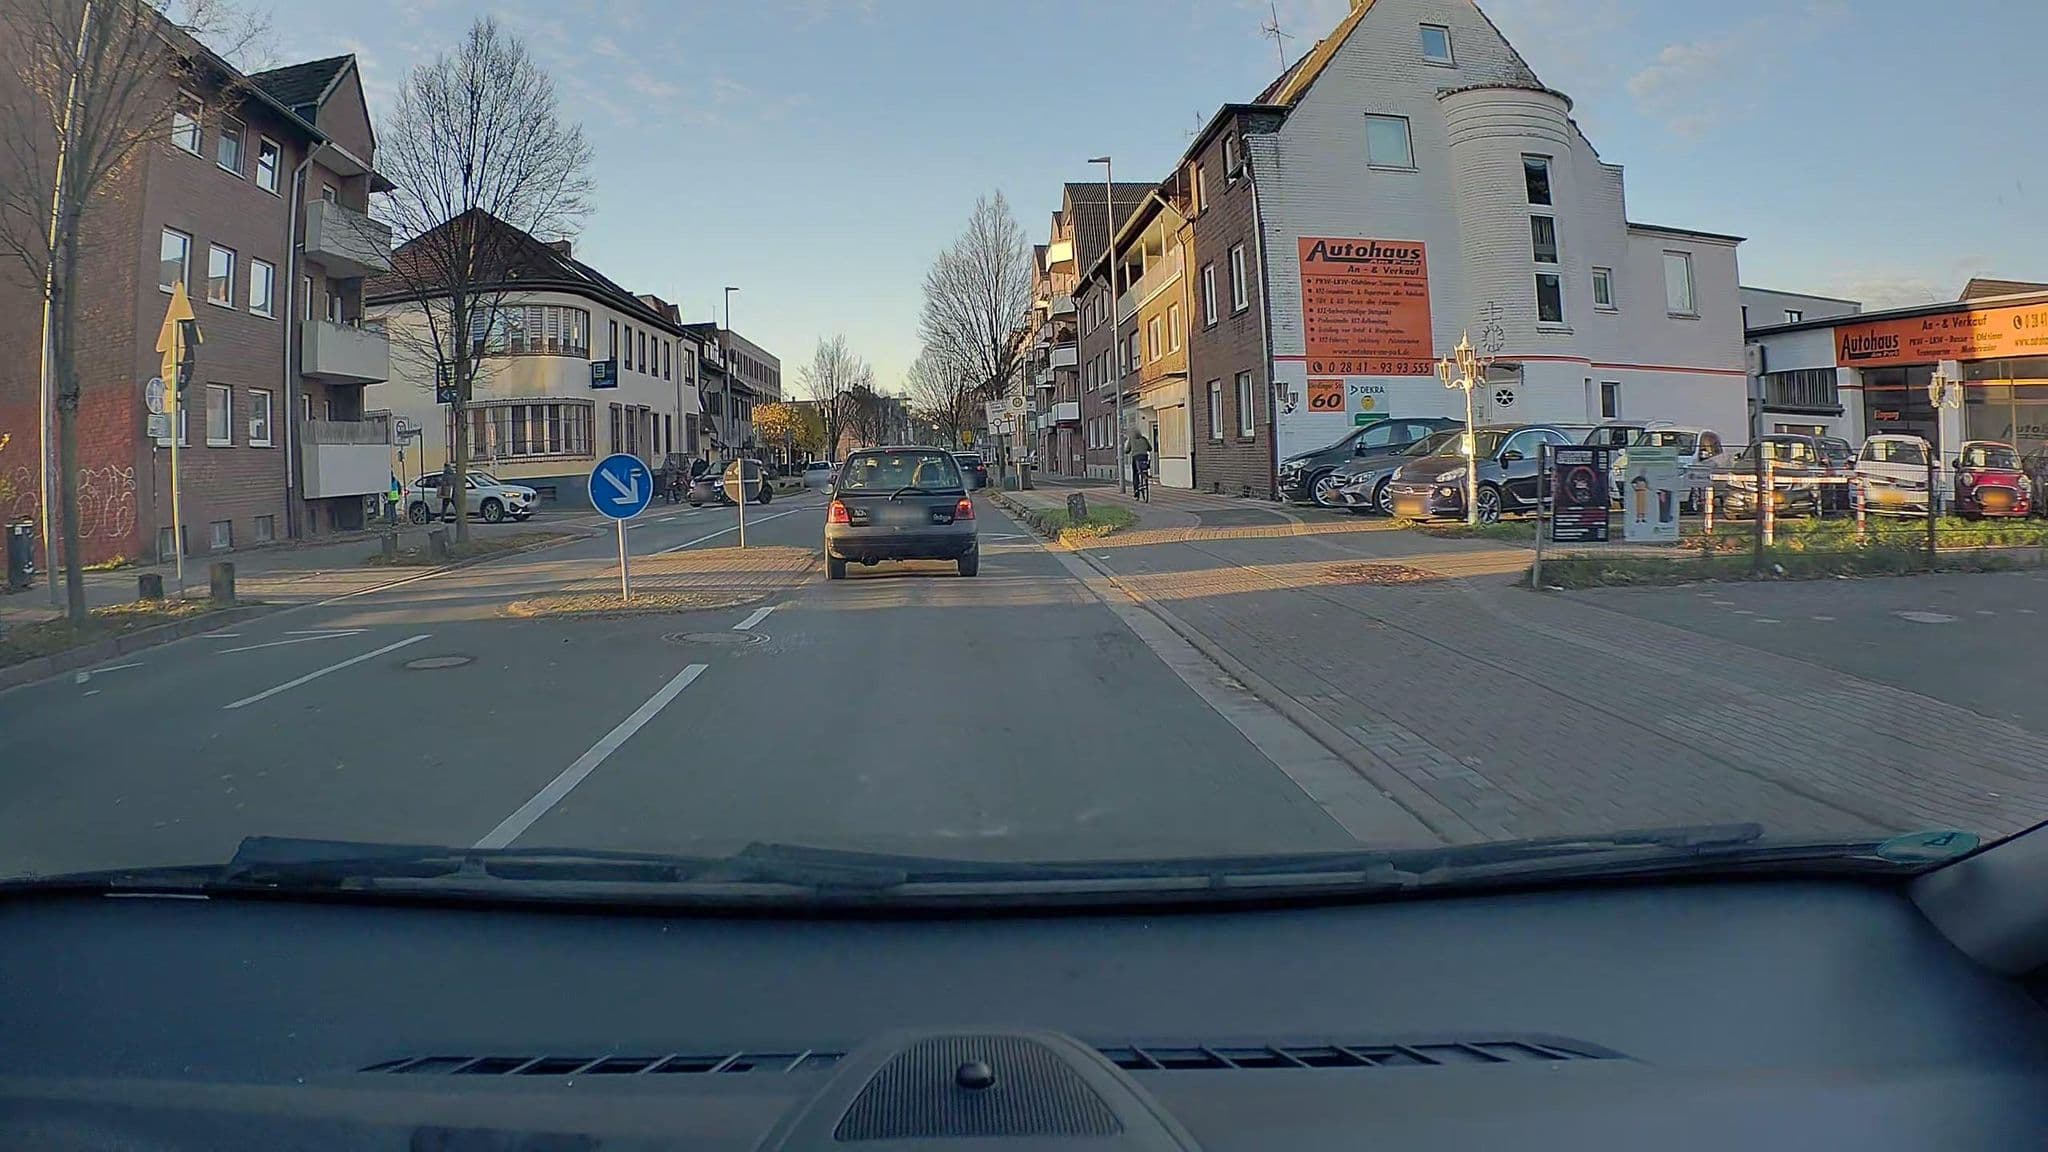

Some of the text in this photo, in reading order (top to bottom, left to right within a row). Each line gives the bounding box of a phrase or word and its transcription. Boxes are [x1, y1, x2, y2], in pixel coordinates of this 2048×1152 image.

[1306, 240, 1420, 262] Autohaus
[1347, 265, 1360, 273] An
[1371, 266, 1378, 274] &
[1383, 266, 1420, 275] Verkauf
[1922, 319, 1933, 331] An
[1952, 314, 1987, 329] Verkauf
[1840, 328, 1899, 361] Autohaus
[1328, 362, 1335, 373] 0
[1340, 361, 1352, 373] 28
[1356, 362, 1367, 373] 41
[1380, 362, 1392, 373] 93
[1396, 363, 1408, 373] 93
[1412, 363, 1429, 374] 555
[1360, 385, 1385, 394] DEKRA
[1311, 393, 1341, 408] 60
